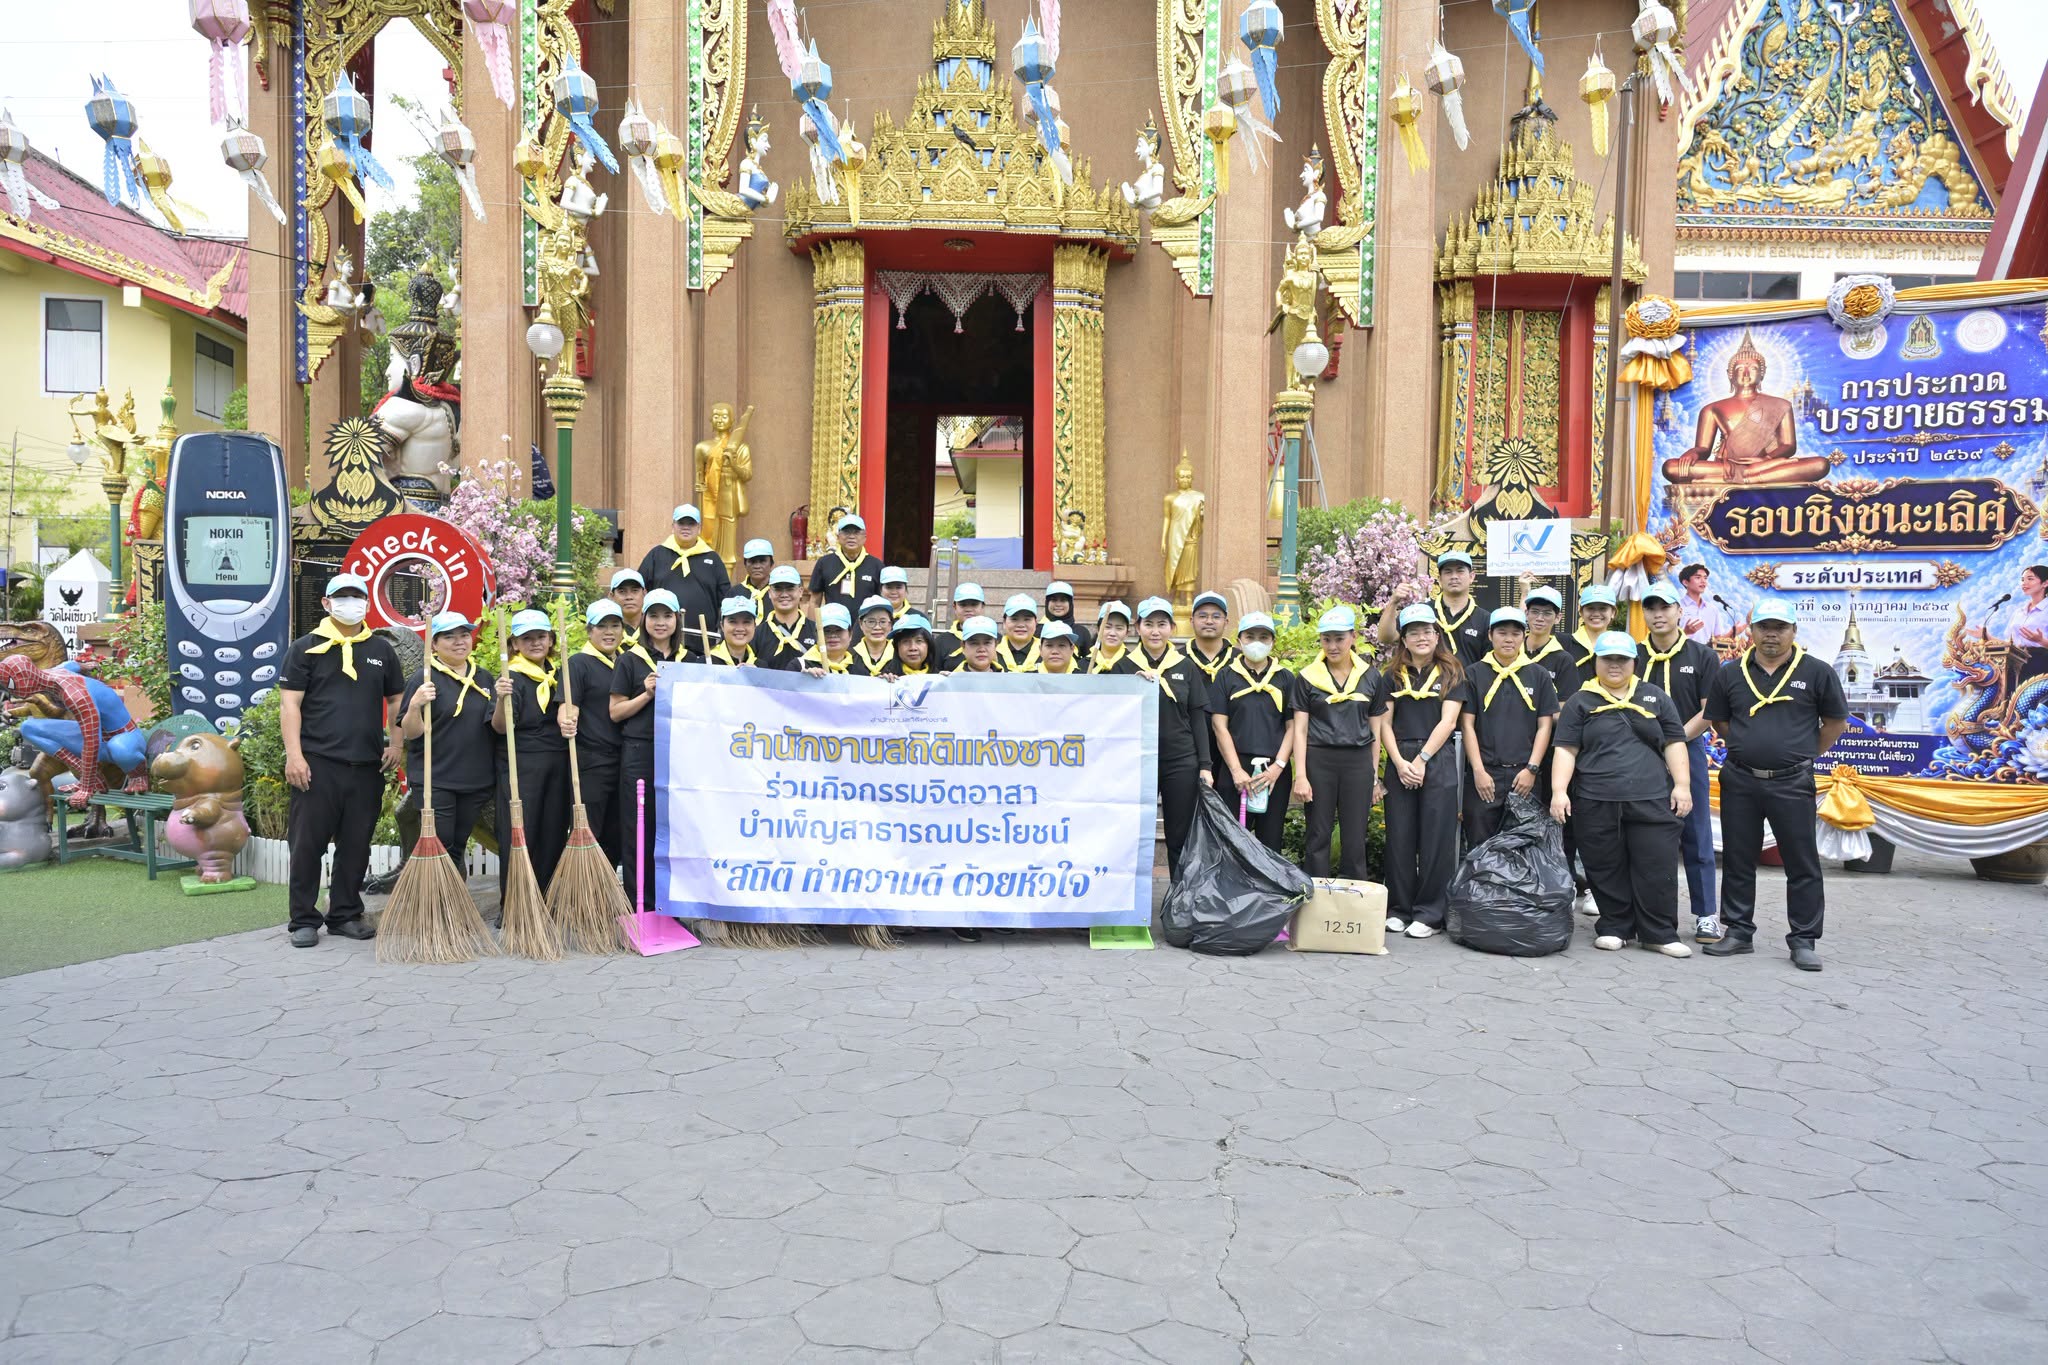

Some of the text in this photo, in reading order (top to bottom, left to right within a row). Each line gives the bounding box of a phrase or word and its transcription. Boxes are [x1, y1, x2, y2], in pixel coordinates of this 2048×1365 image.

[1841, 371, 2007, 400] การประกวด
[1853, 447, 1984, 465] ประจำปี ๒๕๖๙
[206, 490, 247, 499] NOKIA
[1725, 489, 2008, 537] รอบชิงชนะเลิศ
[209, 528, 244, 539] NOKIA
[350, 527, 469, 582] Check-in
[215, 573, 238, 581] Menu
[1793, 566, 1923, 585] ระดับประเทศ
[1821, 603, 1841, 611] ๑๑
[1849, 602, 1907, 614] กรกฎาคม
[366, 657, 383, 667] NSO
[730, 722, 1086, 767] สำนักงานสถิติแห่งชาติ
[766, 771, 1038, 805] ร่วมกิจกรรมจิตอาสา
[739, 808, 1071, 846] บำเพ็ญสาธารณประโยชน์
[801, 858, 947, 897] ทำความดี
[1324, 920, 1361, 934] 12.51
